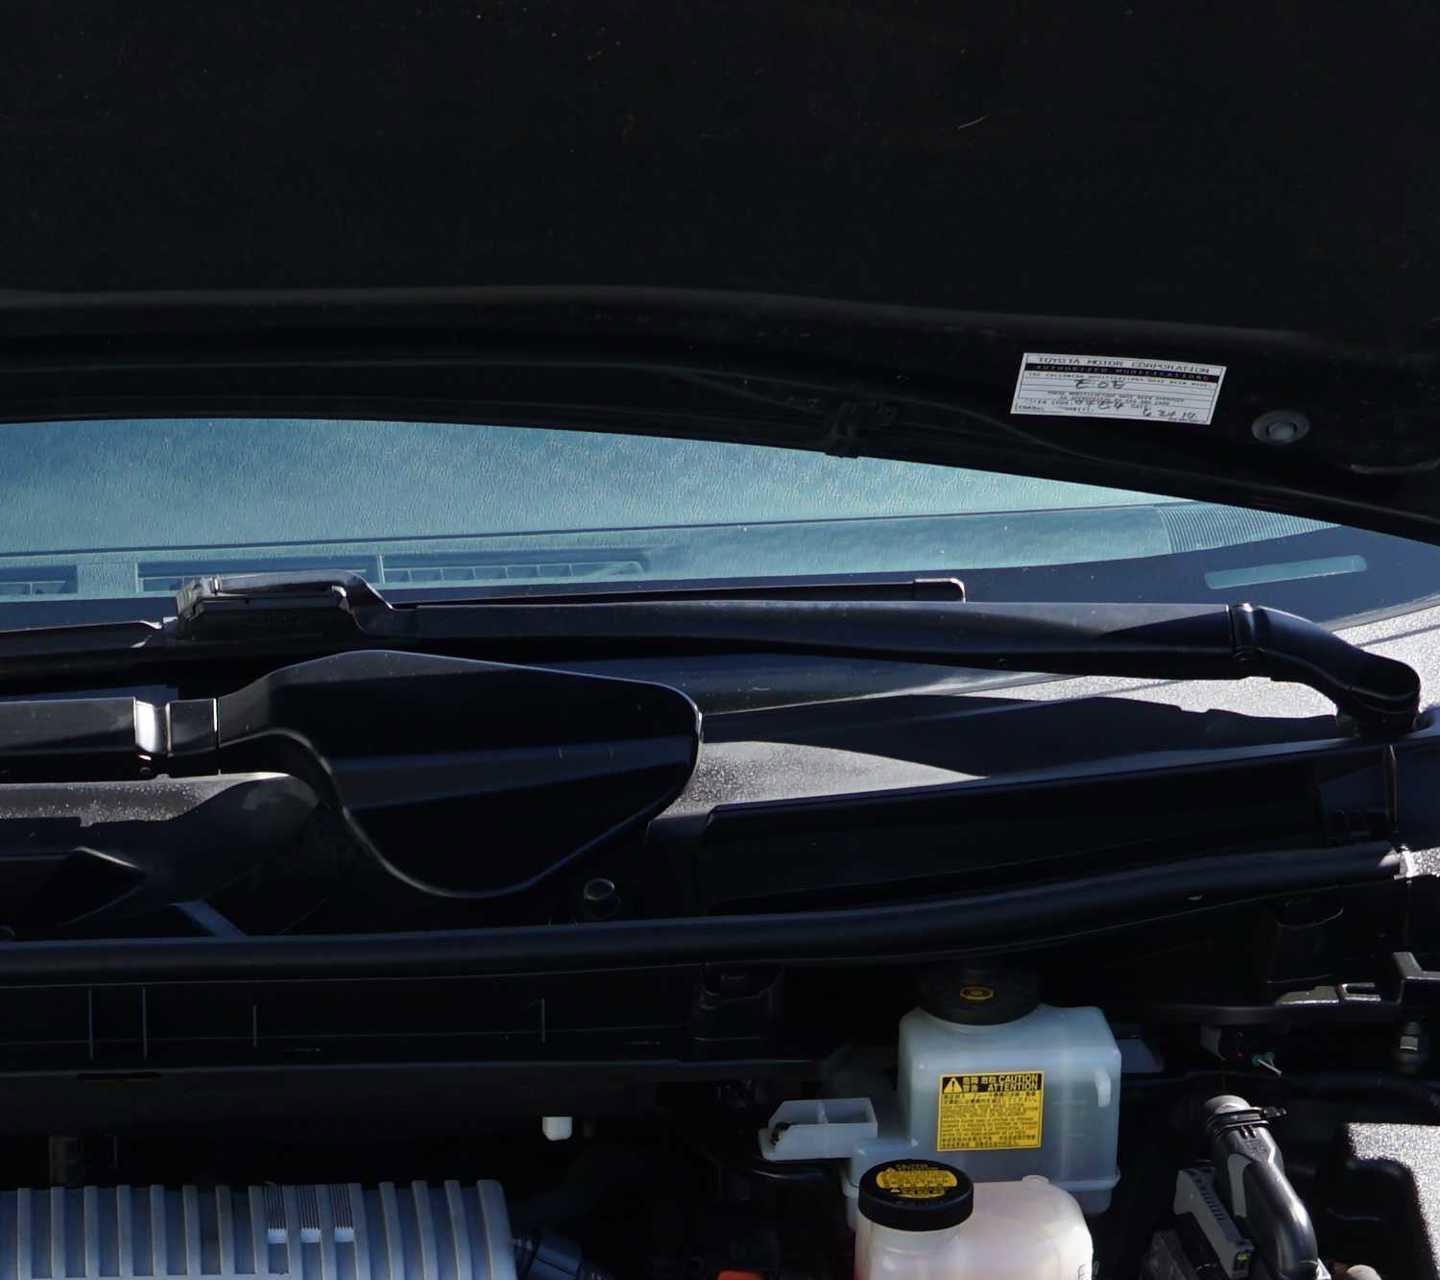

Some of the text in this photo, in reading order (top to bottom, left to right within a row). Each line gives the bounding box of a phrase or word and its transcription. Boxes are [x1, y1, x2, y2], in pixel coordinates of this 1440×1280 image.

[1087, 358, 1124, 368] MOTOR
[1131, 361, 1210, 374] CORPORATION
[998, 1073, 1038, 1083] CAUTION
[987, 1082, 1038, 1092] ATTENTION
